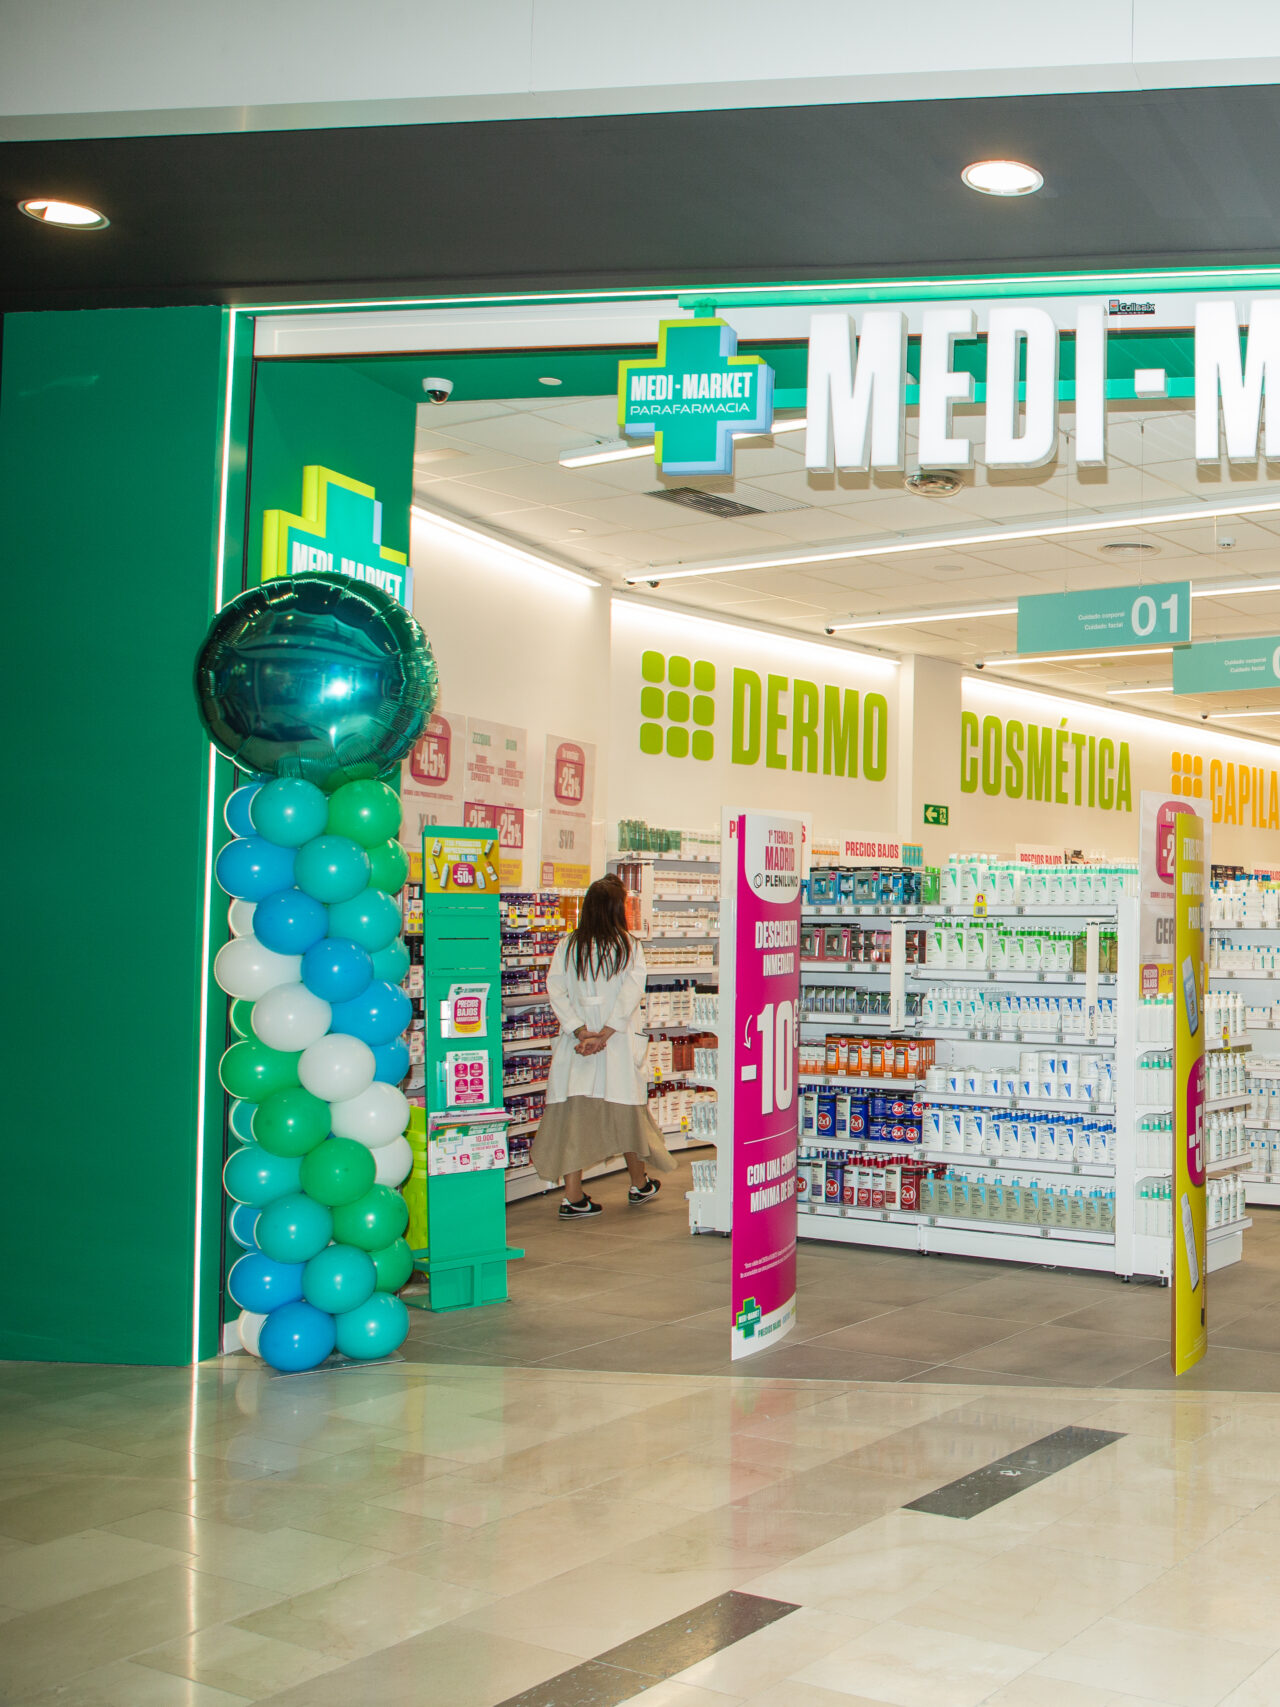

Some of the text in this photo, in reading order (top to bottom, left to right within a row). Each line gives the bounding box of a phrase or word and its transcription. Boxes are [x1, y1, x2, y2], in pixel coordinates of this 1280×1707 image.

[631, 372, 753, 402] MEDI-MARKET
[630, 402, 750, 416] PARAFARMACIA
[1131, 593, 1178, 637] 01
[731, 667, 888, 782] DERMO
[415, 741, 446, 779] -45%
[960, 717, 1132, 812] COSMÉTICA
[559, 829, 575, 850] SVR
[845, 841, 899, 859] PRECIOS BAJOS
[765, 846, 795, 872] MADRID
[453, 870, 474, 884] -50%
[765, 874, 799, 888] PLENILUNIO
[755, 920, 798, 949] DESCUENTO
[763, 953, 795, 977] INMEDIATO
[456, 1008, 478, 1016] BAJOS
[818, 1115, 830, 1126] 2x1
[850, 1117, 863, 1128] 2x1
[746, 1163, 766, 1187] CON
[766, 1158, 781, 1182] UNA
[826, 1182, 839, 1192] 2x1
[902, 1189, 914, 1200] 2x1
[750, 1186, 780, 1214] MÍNIMA
